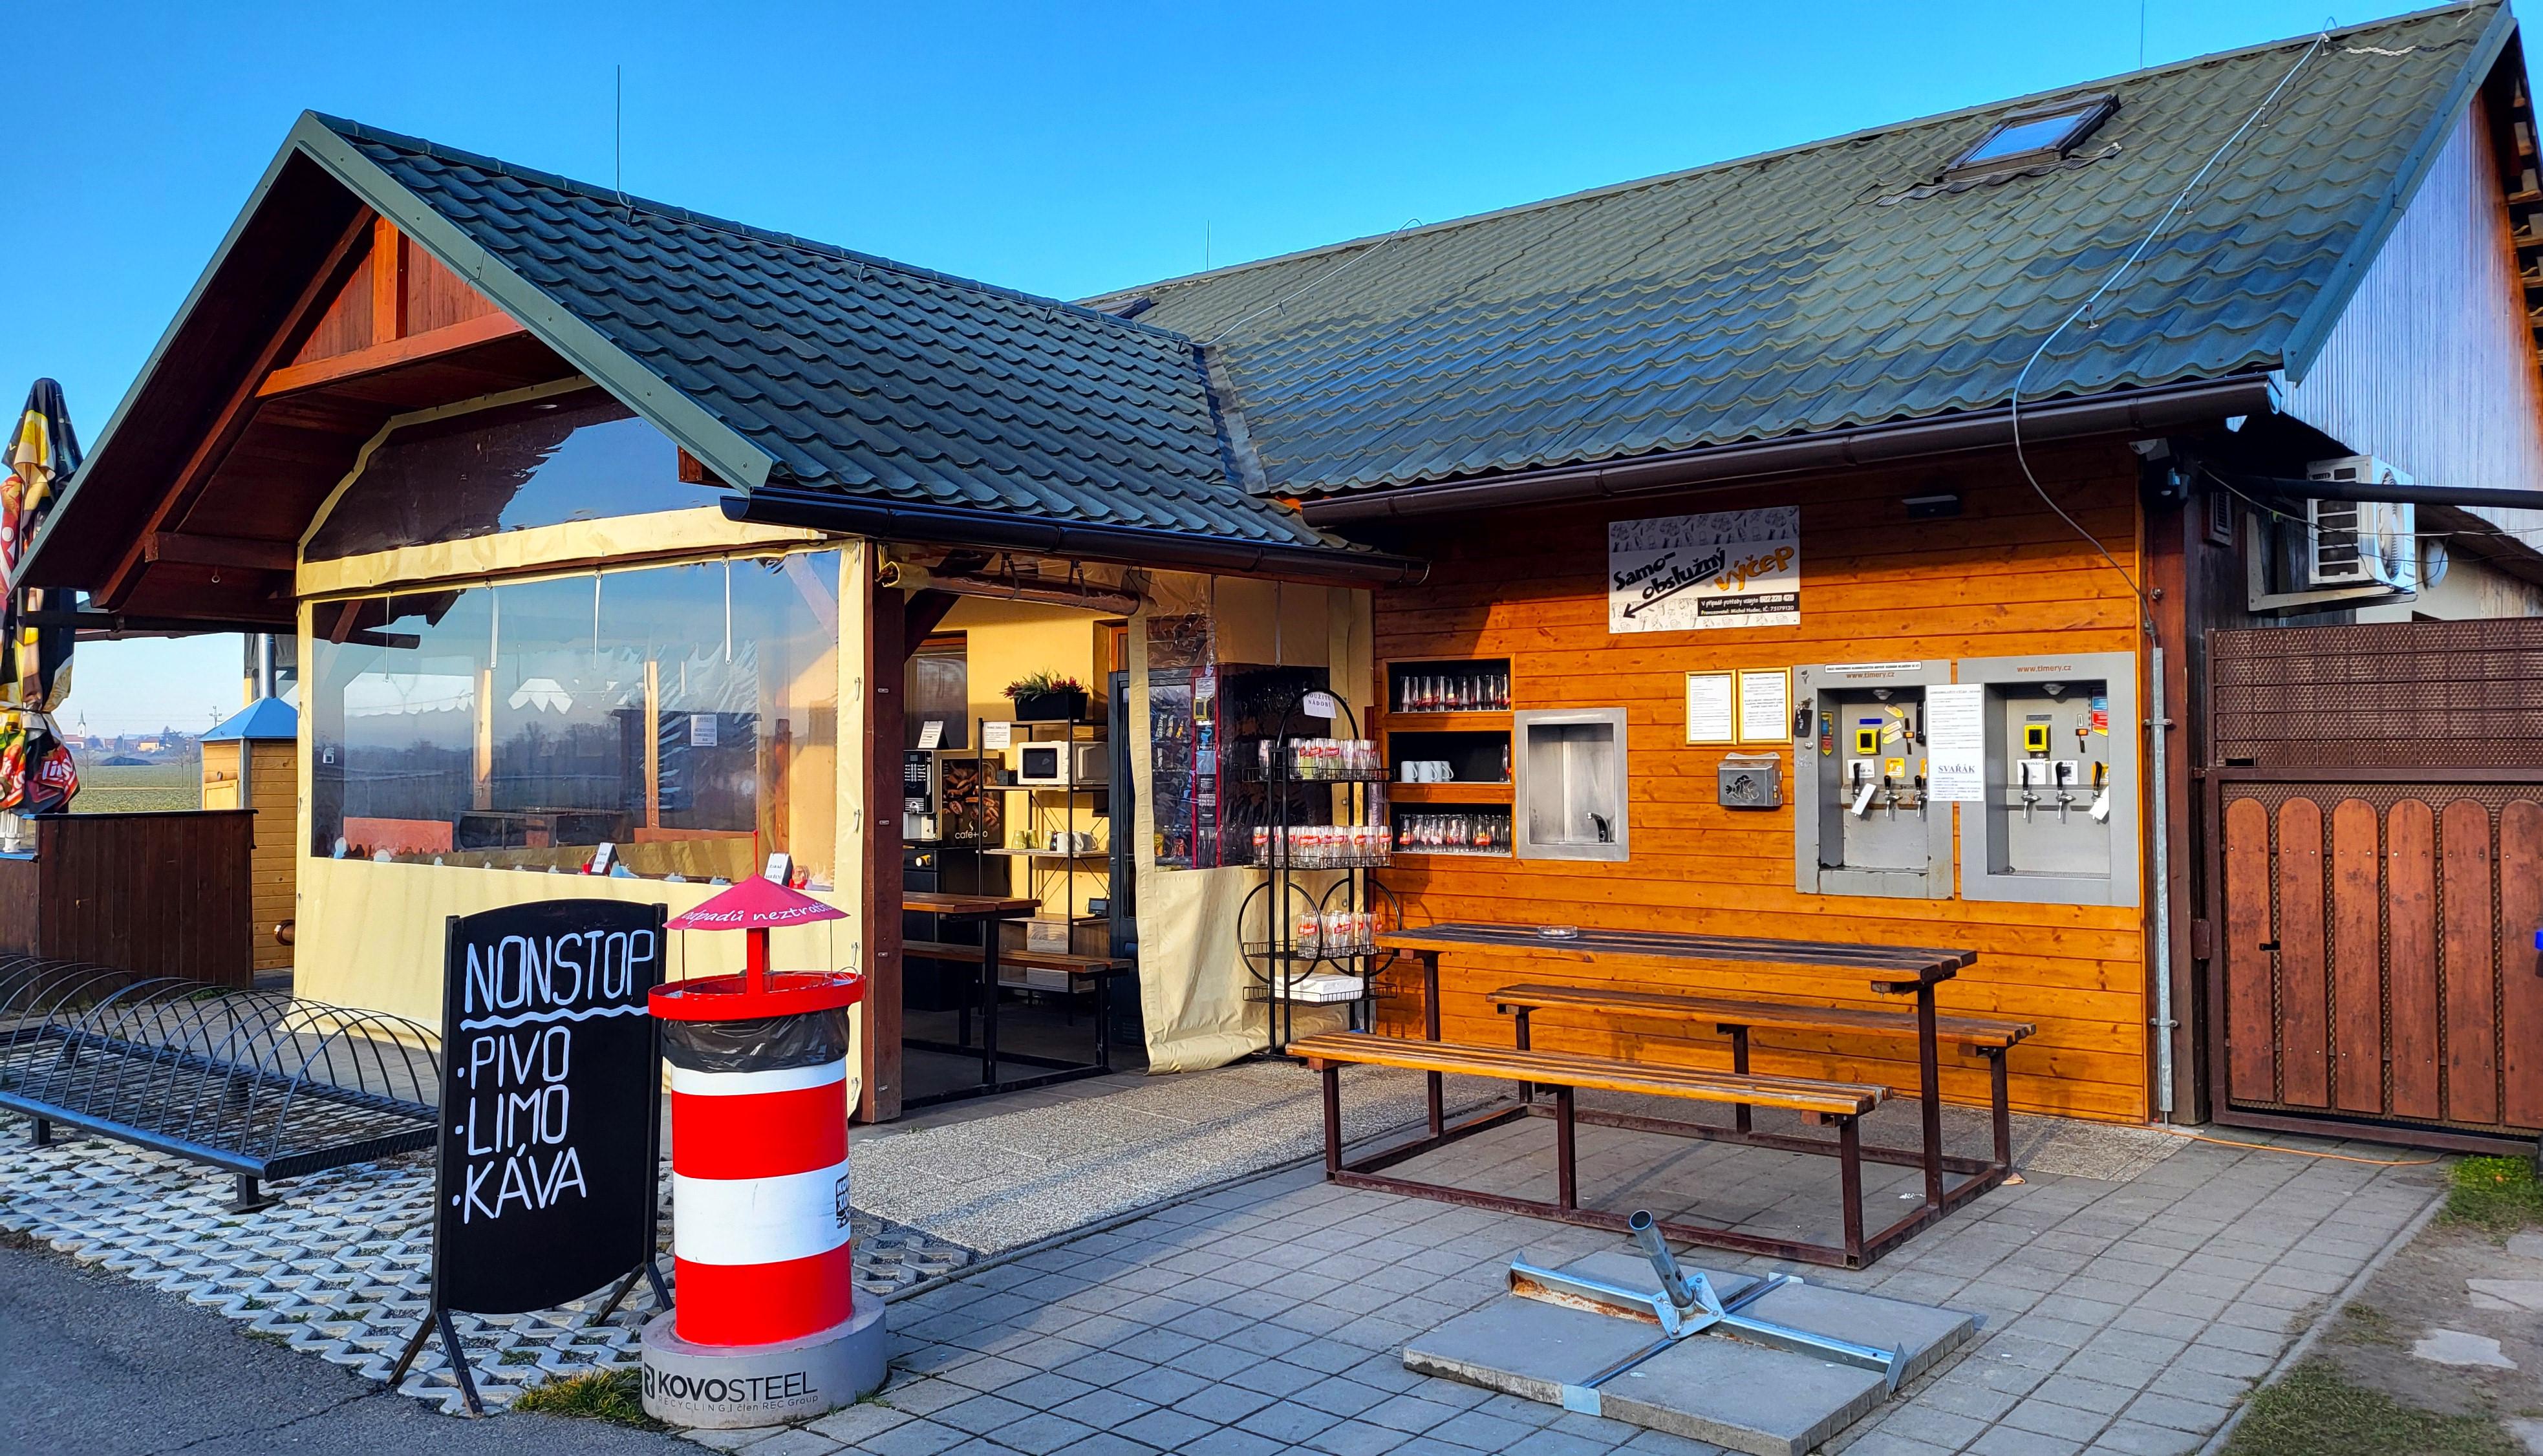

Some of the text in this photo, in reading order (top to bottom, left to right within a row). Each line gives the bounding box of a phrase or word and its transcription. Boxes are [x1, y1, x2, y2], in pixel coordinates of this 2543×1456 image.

[1613, 551, 1676, 591] Samo-
[1642, 547, 1725, 599] obslužný
[464, 930, 654, 1013] NONSTOP
[471, 1025, 571, 1090] PIVO
[467, 1084, 570, 1156] LIMO
[464, 1143, 586, 1225] KÁVA
[658, 1371, 819, 1402] KOVOSTEEL
[736, 1403, 758, 1412] člen
[762, 1400, 784, 1410] REC
[788, 1394, 819, 1407] Group
